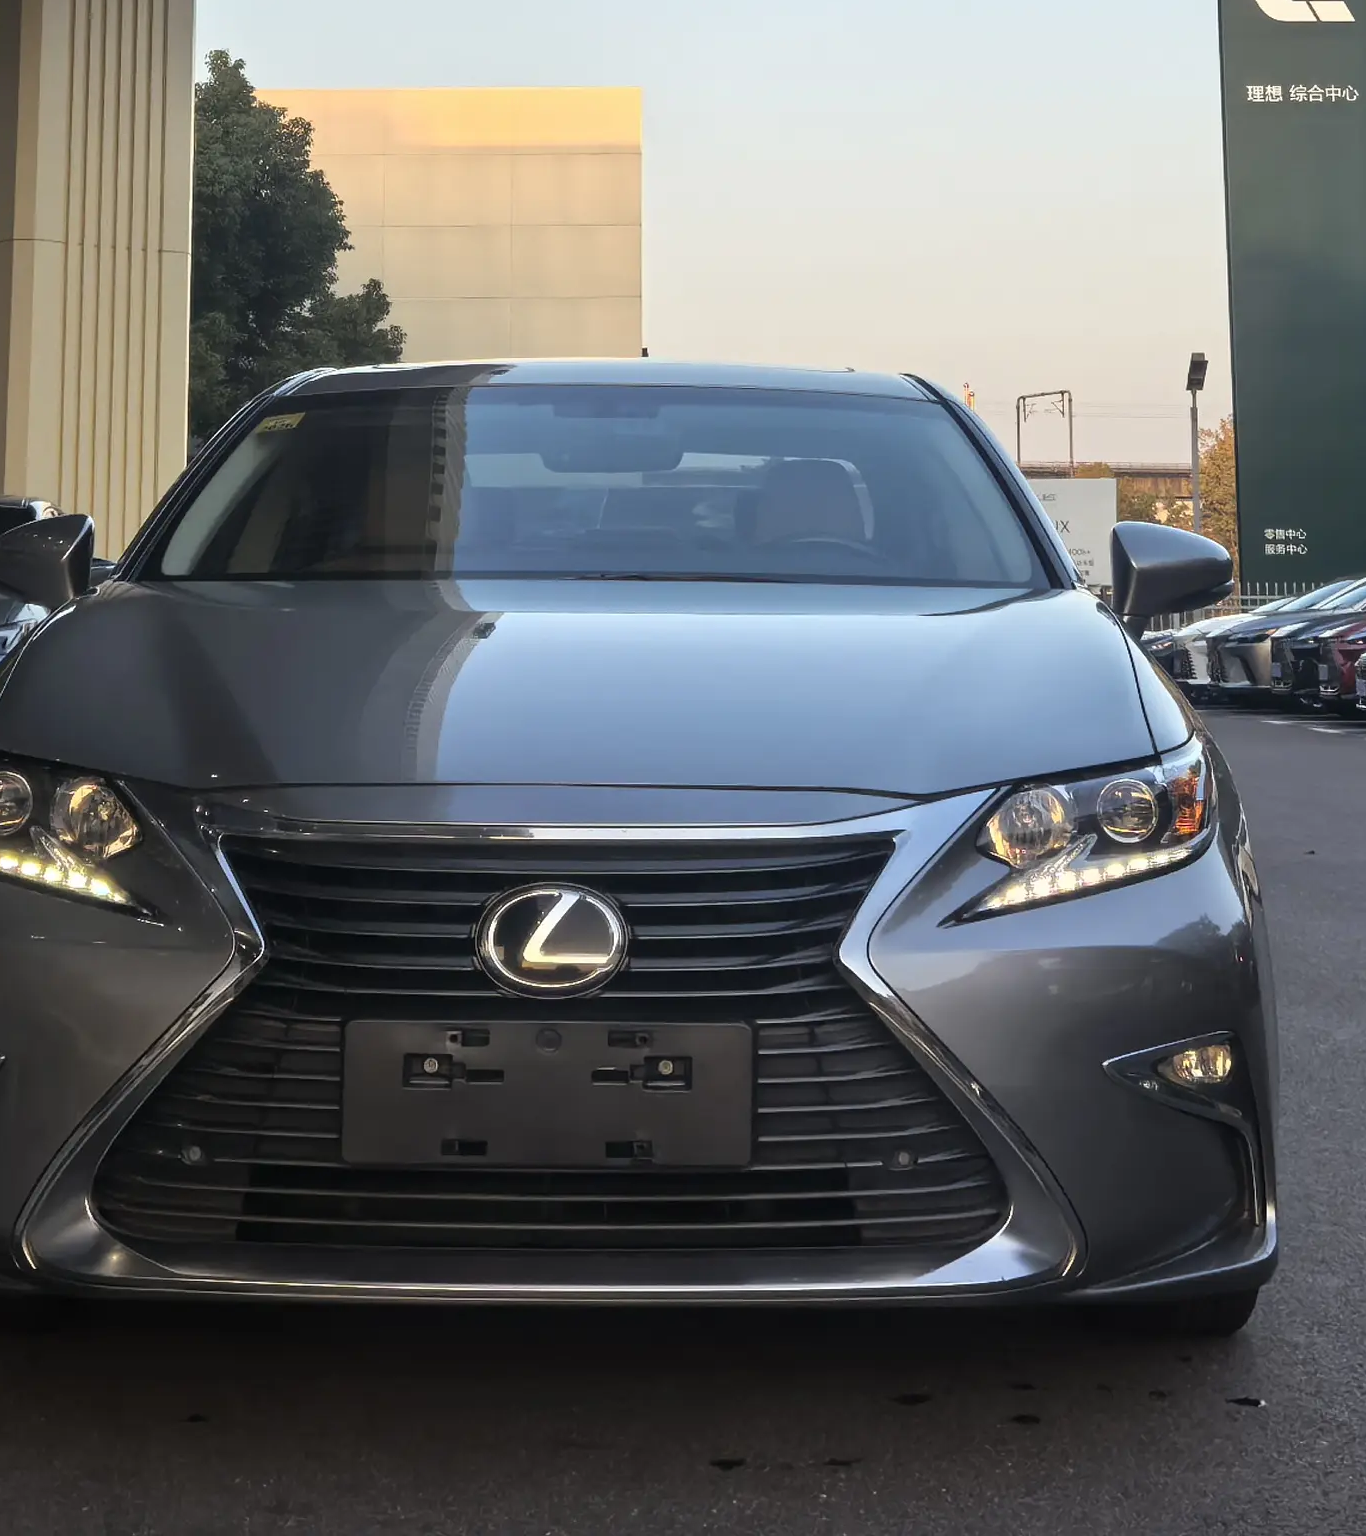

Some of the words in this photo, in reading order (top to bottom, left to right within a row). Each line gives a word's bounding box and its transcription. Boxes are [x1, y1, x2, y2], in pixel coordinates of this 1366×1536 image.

[1245, 84, 1284, 103] 理想
[1289, 84, 1360, 103] 综合中心
[1263, 528, 1307, 540] 零售中心
[1264, 543, 1309, 555] 服务中心
